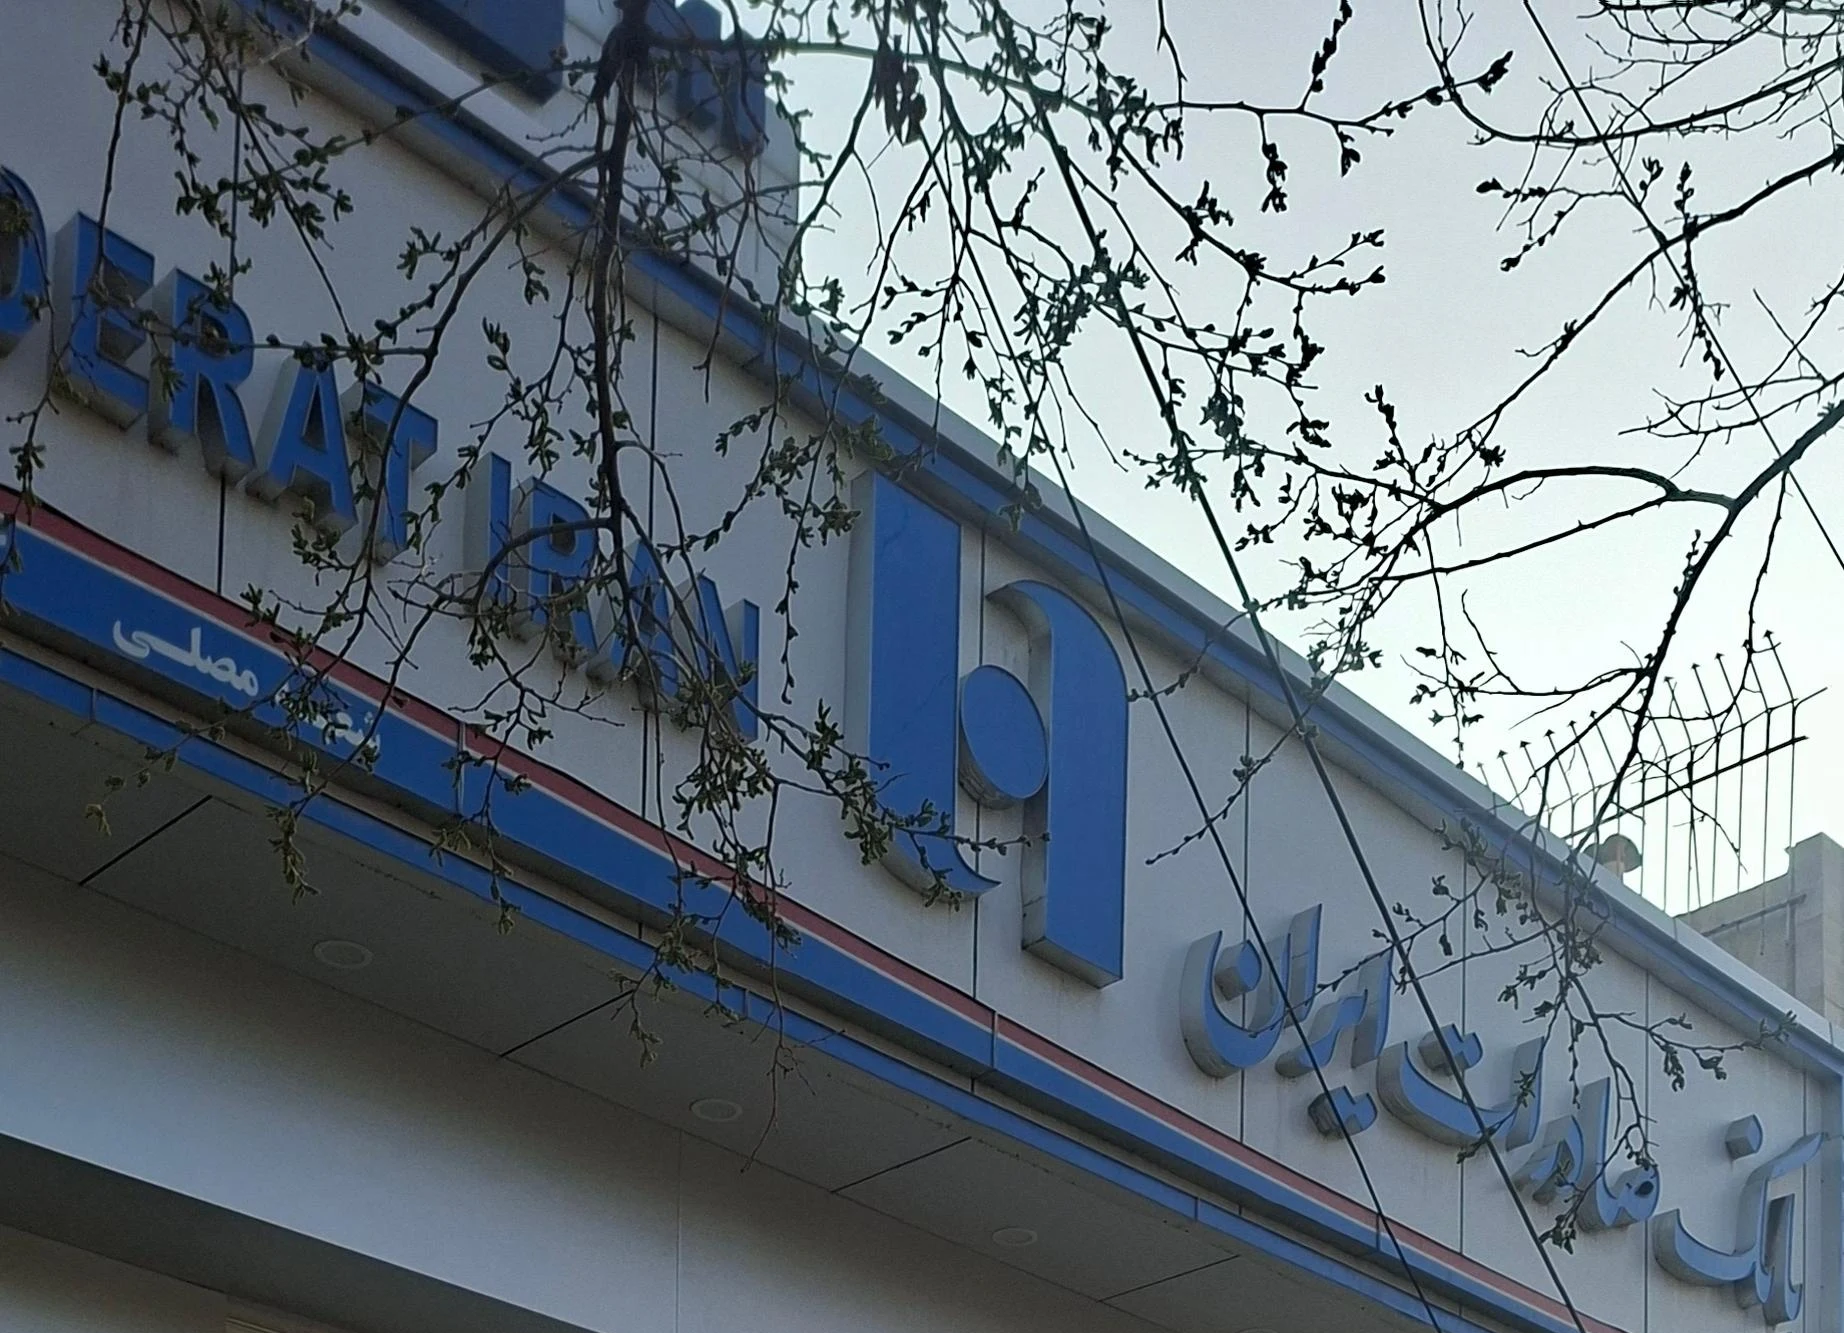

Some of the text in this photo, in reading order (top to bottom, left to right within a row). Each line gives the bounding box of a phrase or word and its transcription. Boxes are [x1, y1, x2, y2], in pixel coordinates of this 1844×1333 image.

[112, 619, 260, 698] مصلی
[465, 452, 760, 746] IRAN
[1180, 903, 1394, 1140] ایران
[1378, 1023, 1661, 1233] صادرات
